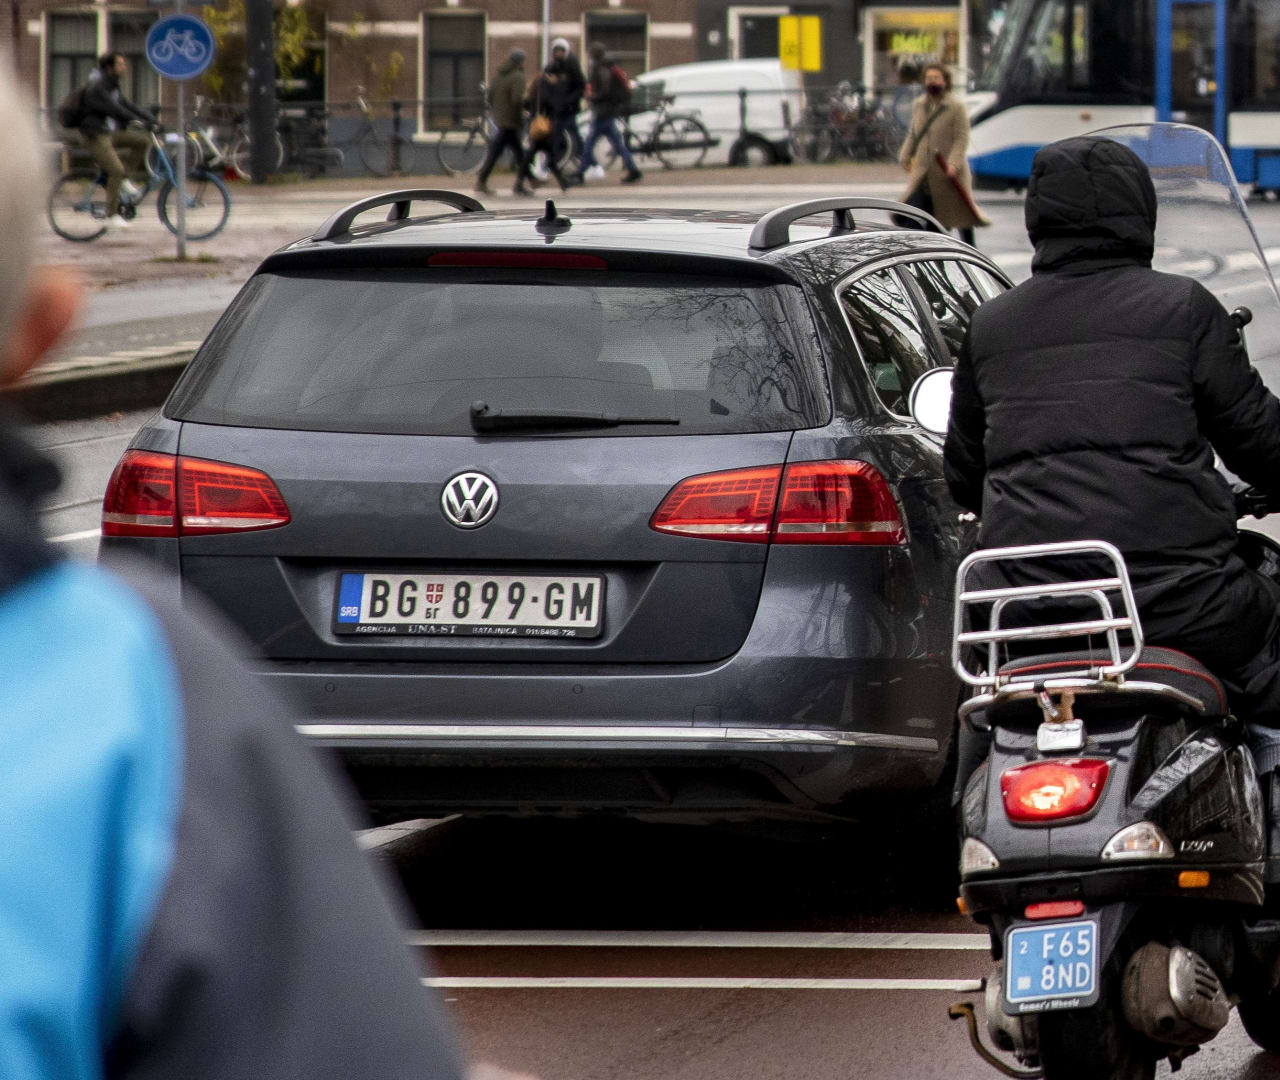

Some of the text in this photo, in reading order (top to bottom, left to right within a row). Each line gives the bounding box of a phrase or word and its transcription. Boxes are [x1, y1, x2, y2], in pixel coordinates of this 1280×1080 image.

[340, 606, 359, 617] SRB
[369, 580, 417, 617] BG
[1019, 928, 1091, 959] 2 F65
[1040, 961, 1091, 991] 8ND
